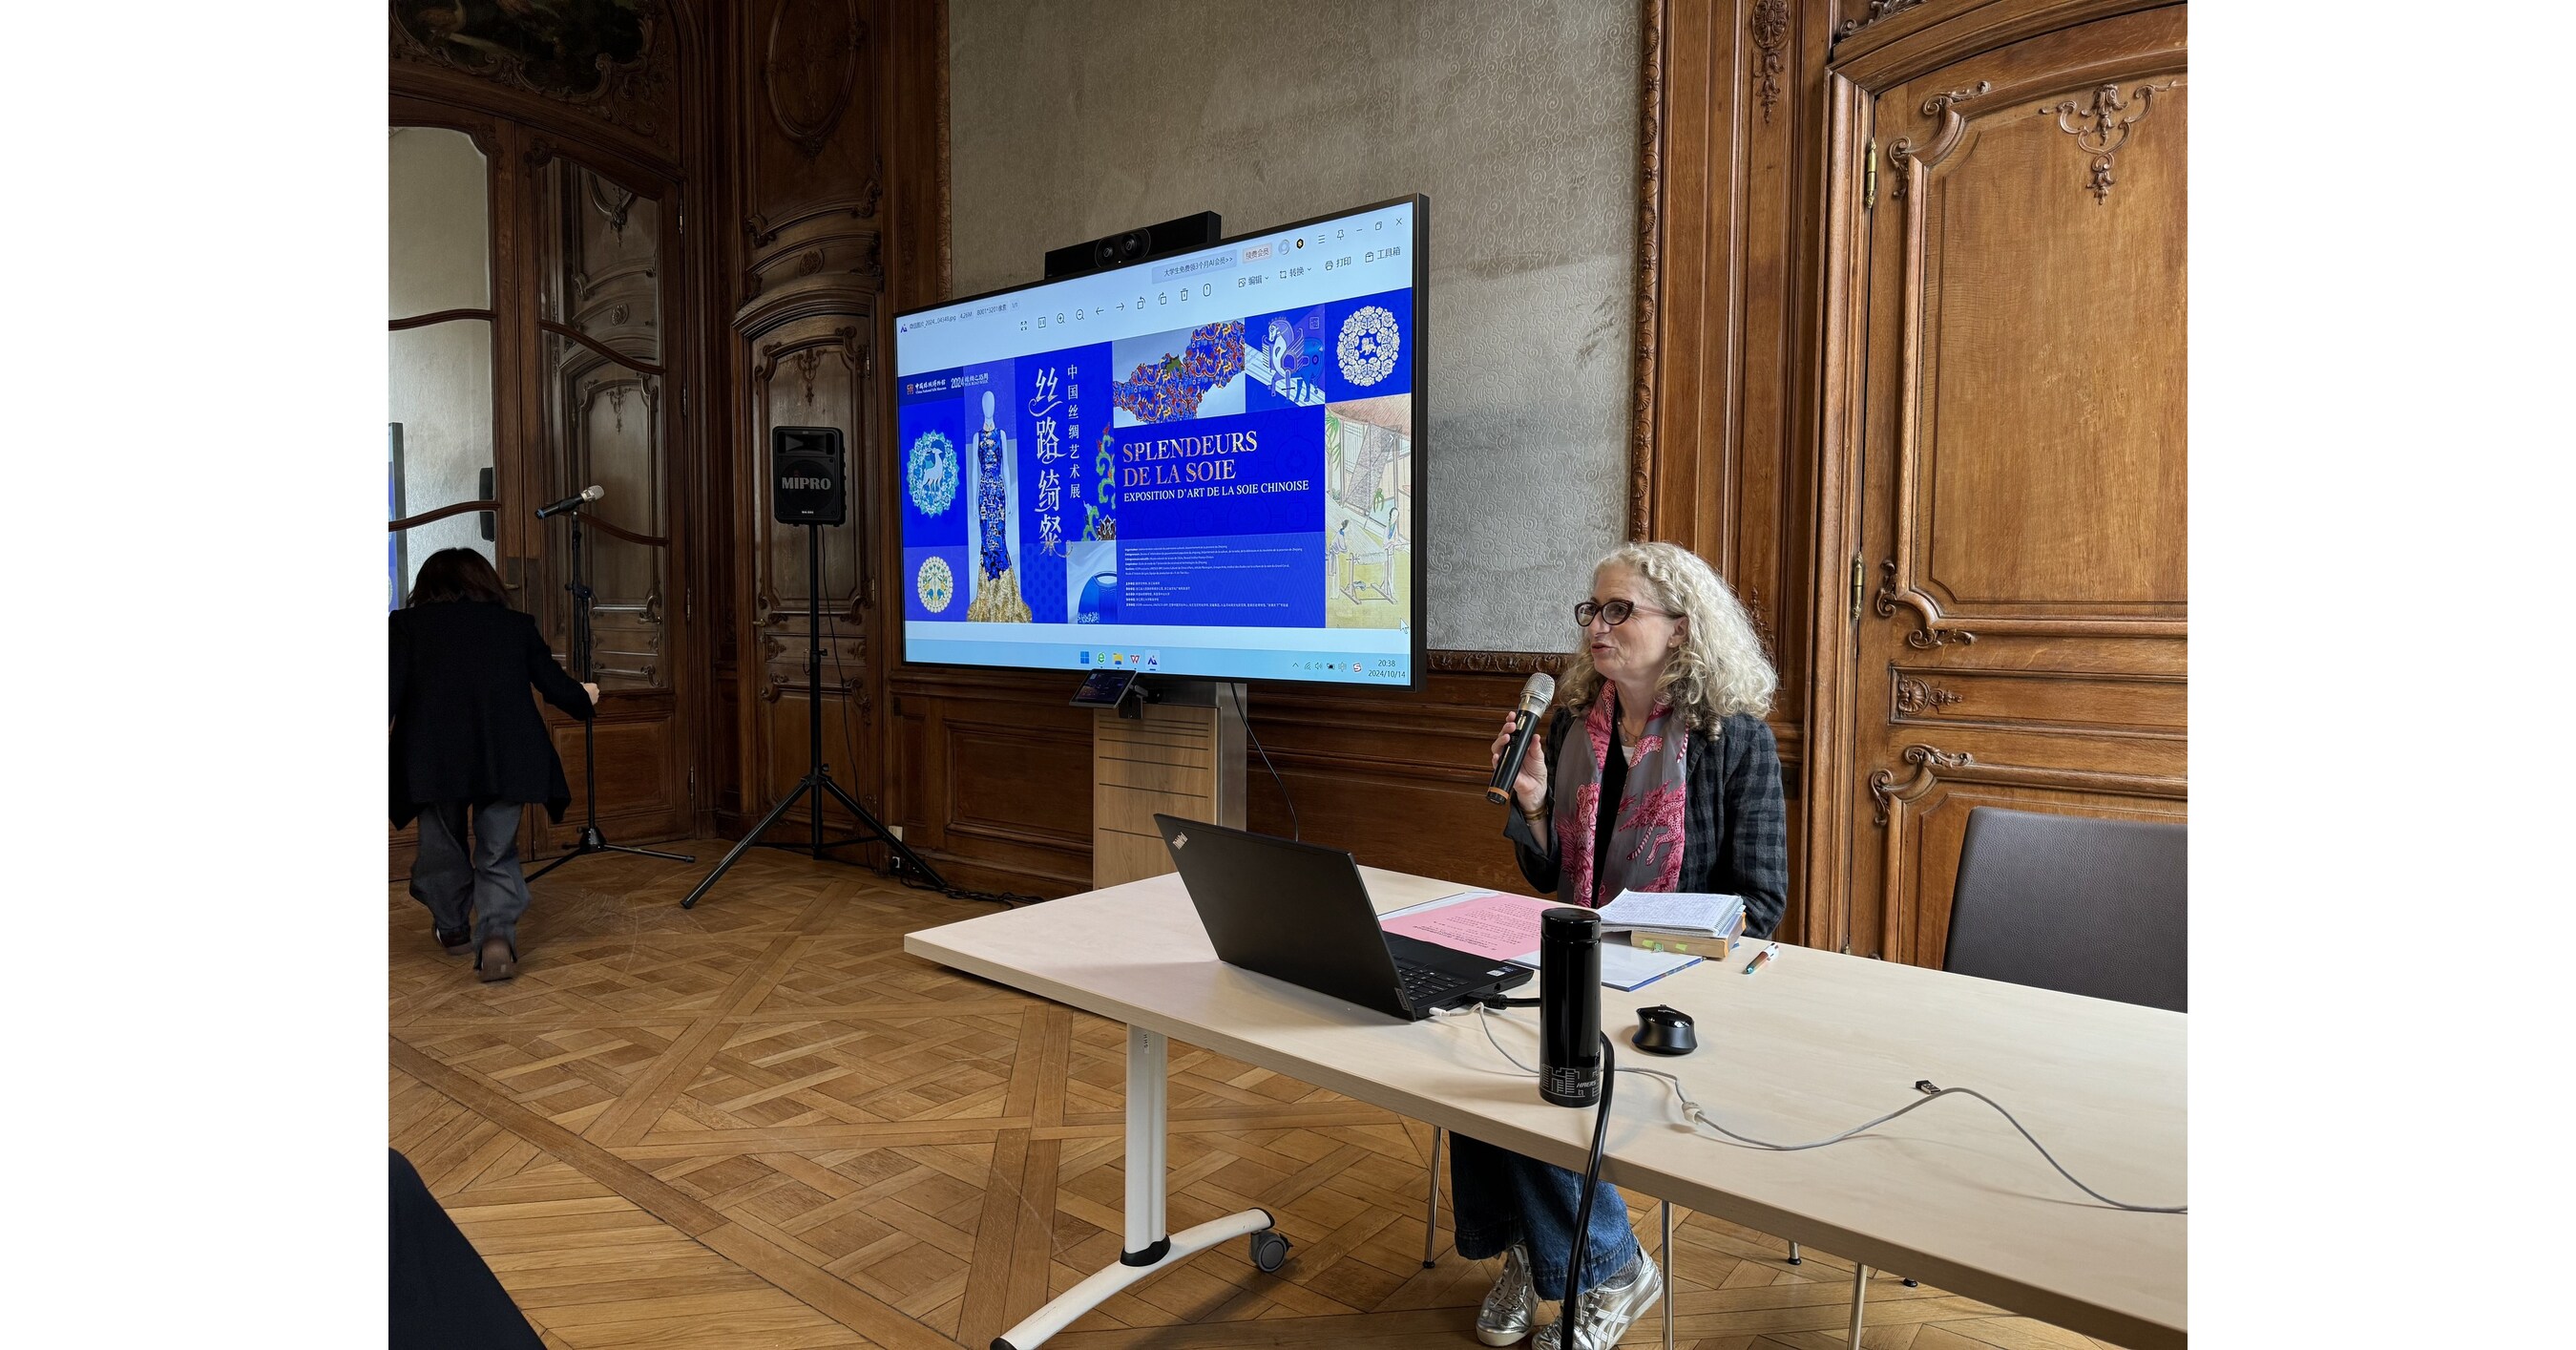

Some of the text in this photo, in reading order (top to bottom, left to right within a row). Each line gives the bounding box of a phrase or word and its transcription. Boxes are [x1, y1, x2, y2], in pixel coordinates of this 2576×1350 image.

[1246, 248, 1269, 260] 续费会员
[1377, 246, 1401, 260] 工具箱
[1336, 256, 1351, 267] 打印
[1289, 266, 1305, 278] 转换
[1248, 275, 1263, 285] 编辑
[951, 377, 965, 389] 2024
[1067, 364, 1080, 498] 中国丝绸艺术展
[1122, 431, 1258, 463] SPLENDEURS
[1123, 459, 1236, 487] DE LA SOIE
[782, 476, 831, 490] MIPRO
[1124, 479, 1309, 502] EXPOSITION D'ART DE LA SOIE CHINOISE
[1368, 669, 1406, 679] 2024/10/14
